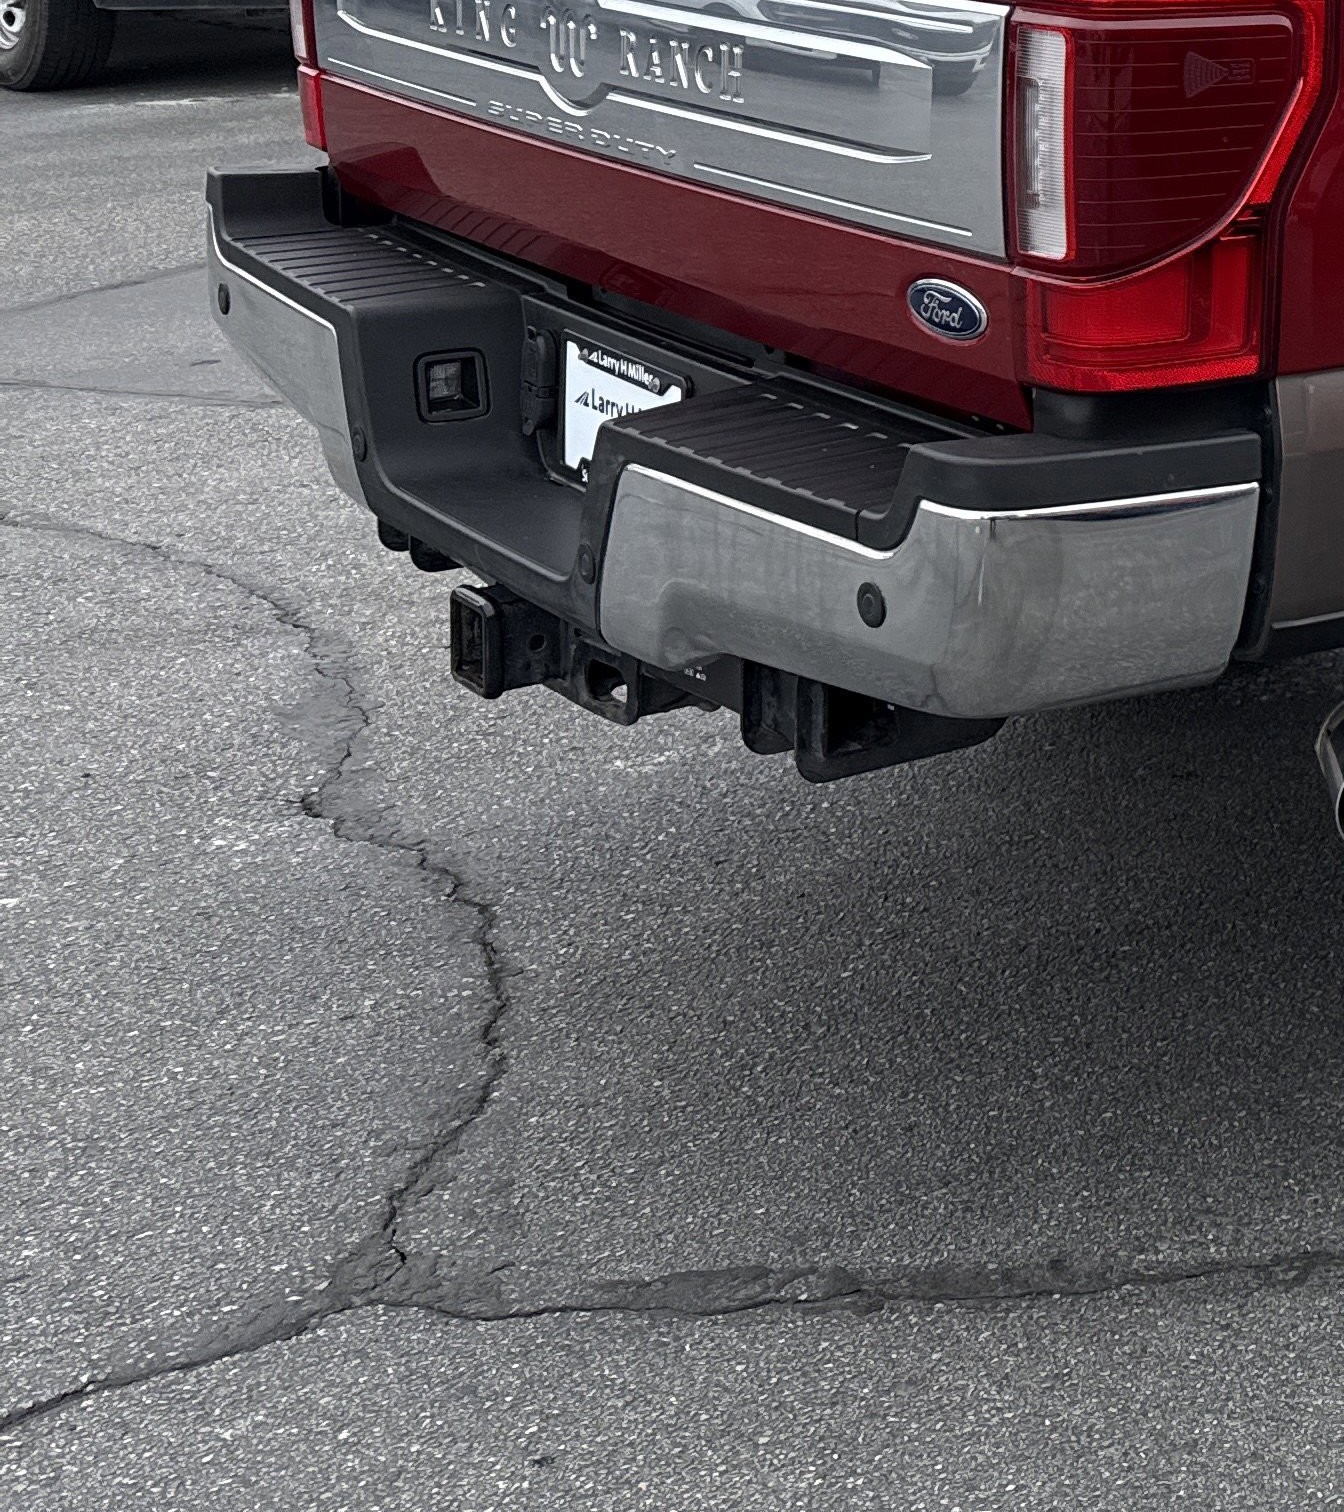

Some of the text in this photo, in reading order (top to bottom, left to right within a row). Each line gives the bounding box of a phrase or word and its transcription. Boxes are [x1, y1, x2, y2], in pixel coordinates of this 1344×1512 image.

[618, 29, 744, 104] RANCH
[488, 100, 677, 165] SUPER DUTY
[920, 290, 963, 329] Ford
[598, 349, 654, 386] Larry H Miller
[591, 387, 624, 418] Larry
